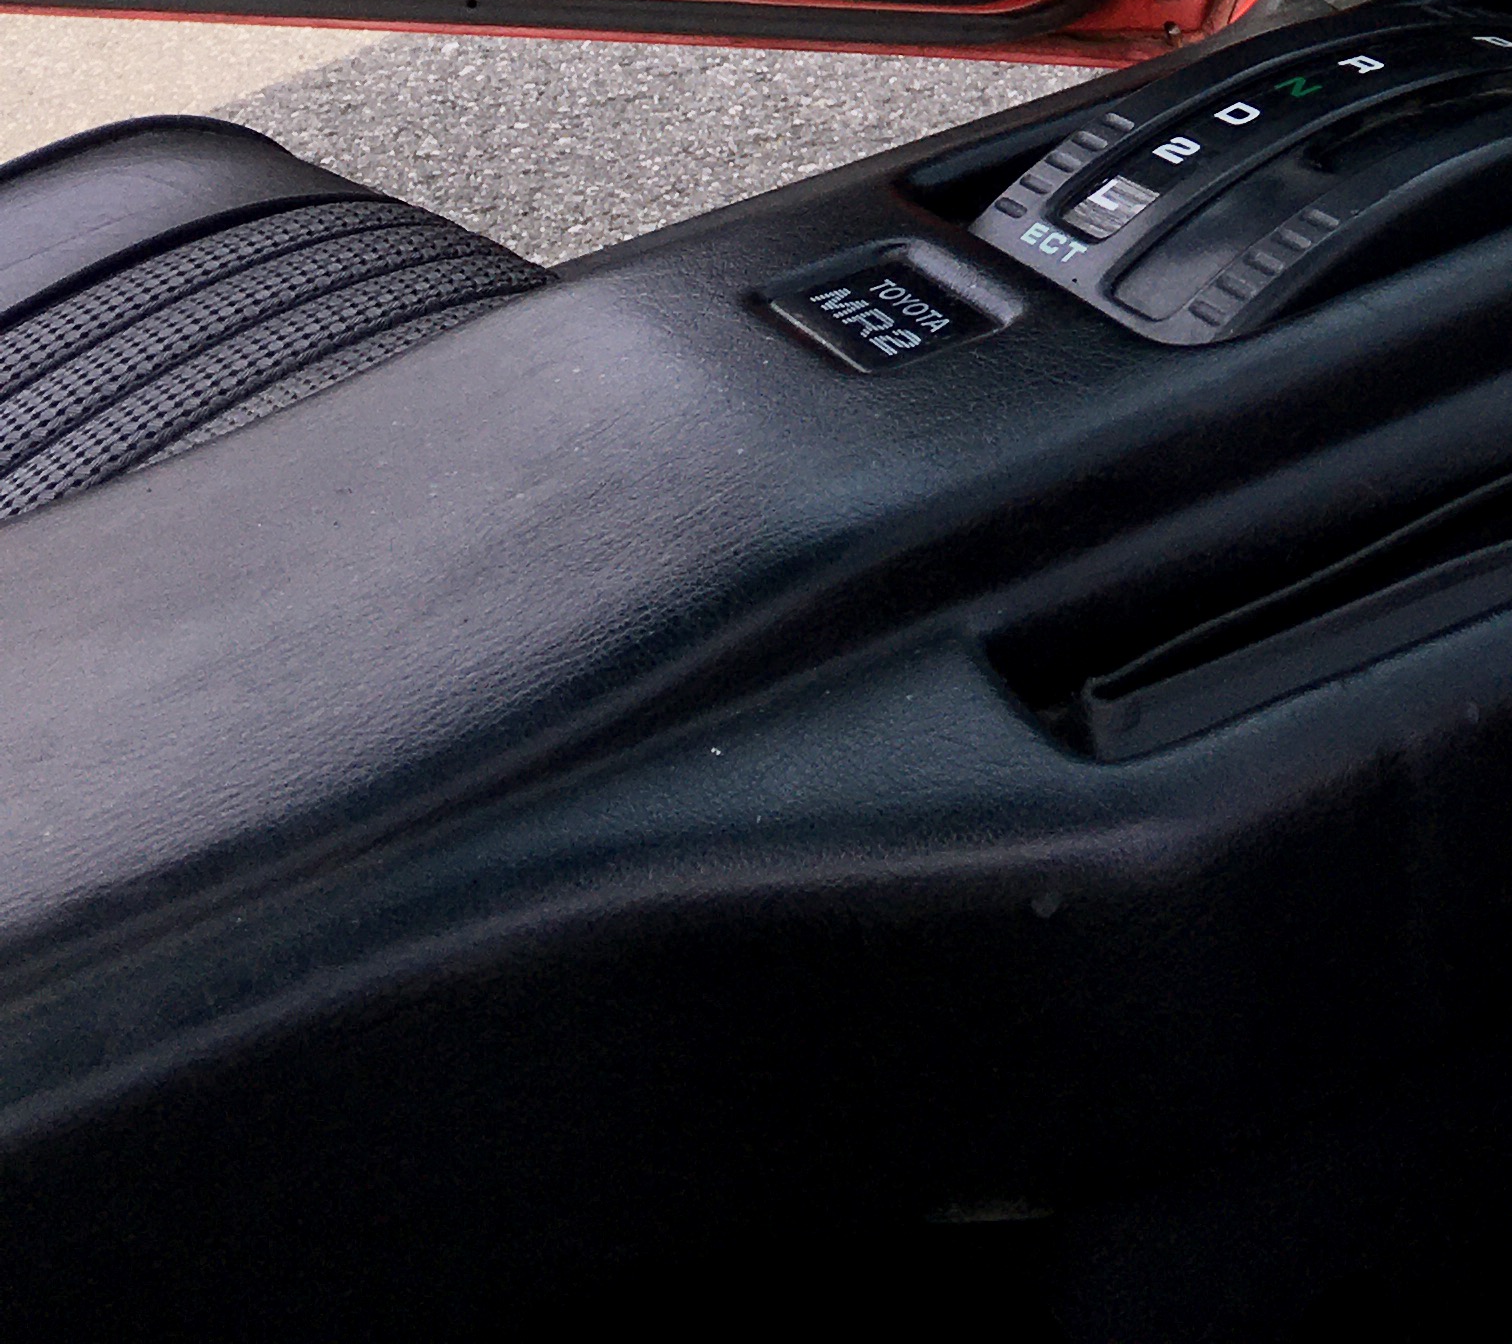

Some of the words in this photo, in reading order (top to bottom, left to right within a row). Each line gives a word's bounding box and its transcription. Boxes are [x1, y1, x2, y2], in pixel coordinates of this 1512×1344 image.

[1338, 54, 1385, 75] R
[1275, 75, 1323, 99] N
[1214, 101, 1261, 126] D
[1152, 136, 1201, 165] 2
[1087, 177, 1124, 210] L
[1020, 222, 1088, 265] ECT
[869, 278, 950, 333] TOYOTA
[810, 287, 922, 356] MR2
